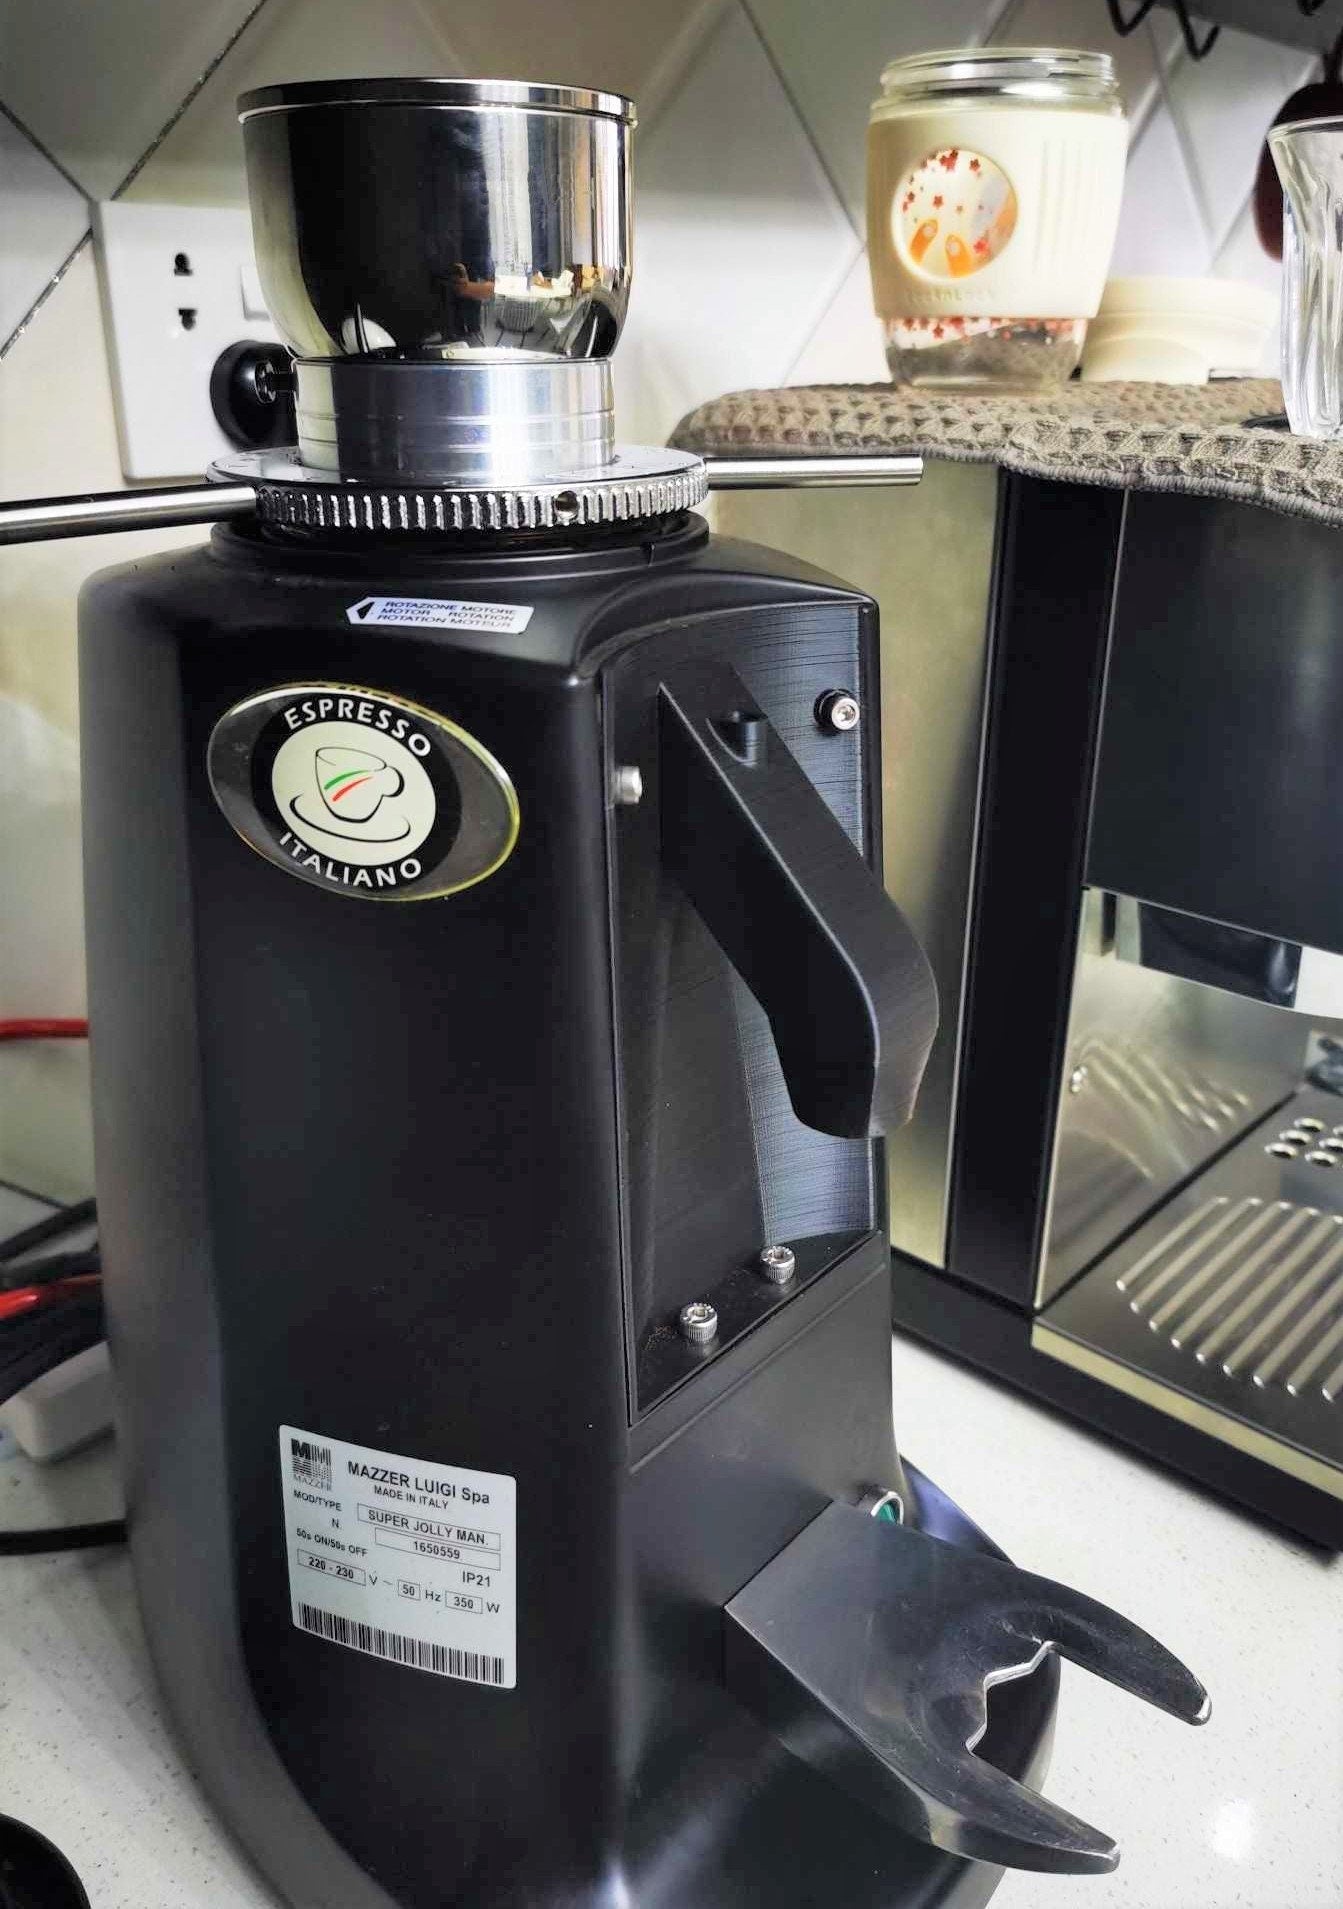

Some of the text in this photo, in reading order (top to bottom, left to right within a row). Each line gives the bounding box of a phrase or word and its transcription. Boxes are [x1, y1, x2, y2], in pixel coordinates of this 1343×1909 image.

[381, 607, 515, 622] MOTOR ROTATION
[385, 601, 516, 615] ROTAZIONE MOTORE
[376, 614, 511, 628] ROTATION MOTEUR
[284, 698, 431, 757] ESPRESSO
[279, 831, 422, 888] ITALIANO
[348, 1461, 490, 1504] MAZZER LUIGI Spa
[293, 1490, 342, 1512] MOD/TYPE
[374, 1485, 449, 1510] MADE IN ITALY
[368, 1509, 409, 1530] SUPER
[413, 1520, 452, 1538] JOLLY
[348, 1545, 369, 1558] OFF
[413, 1541, 461, 1560] 1650559
[308, 1556, 326, 1571] 220
[336, 1565, 354, 1579] 230
[369, 1574, 378, 1586] V
[402, 1584, 415, 1597] 50
[425, 1590, 442, 1603] Hz
[453, 1596, 474, 1609] 350
[486, 1602, 501, 1614] W
[462, 1571, 491, 1587] IP21
